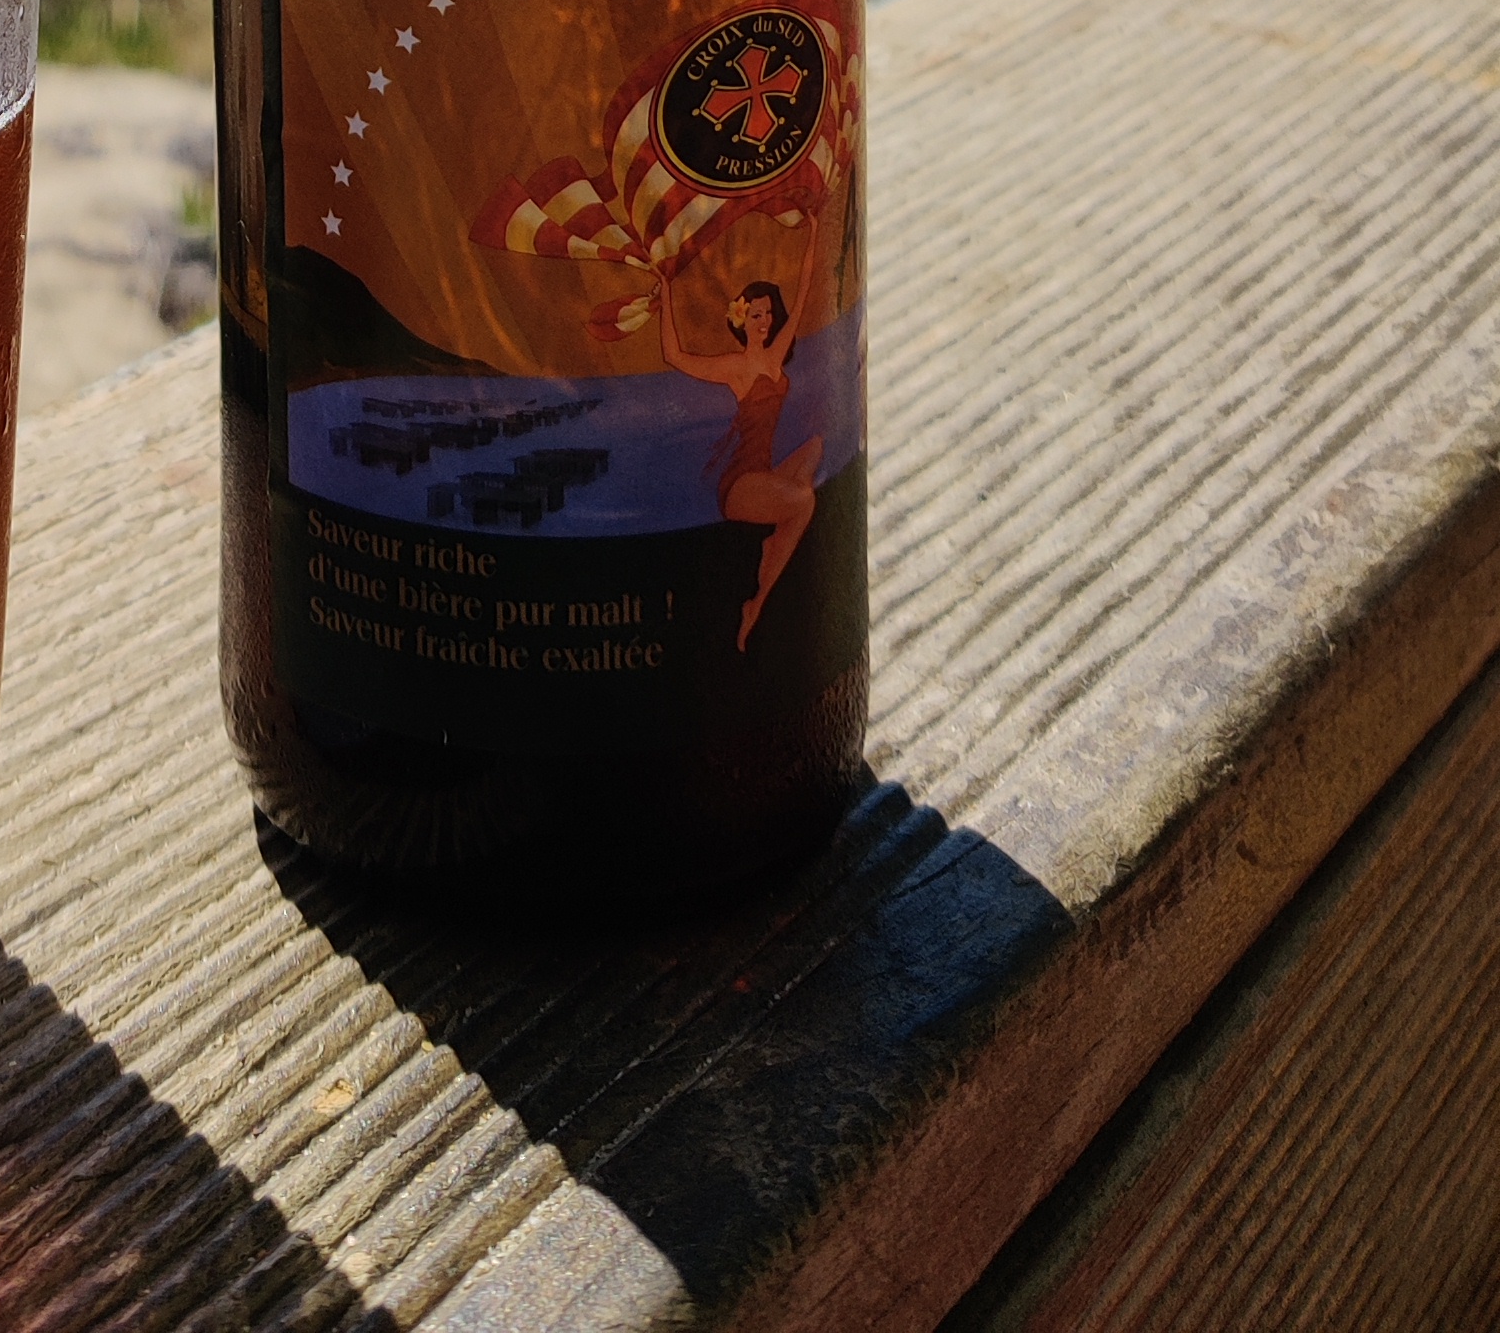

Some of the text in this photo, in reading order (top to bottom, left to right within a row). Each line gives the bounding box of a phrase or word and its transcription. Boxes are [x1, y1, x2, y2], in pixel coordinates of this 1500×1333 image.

[687, 16, 806, 81] CROIX du SUD
[715, 124, 802, 177] PRESSION
[307, 507, 498, 579] Saveur riche
[307, 551, 388, 604] d'une
[397, 575, 485, 622] bière
[493, 598, 556, 632] pur
[566, 590, 644, 628] malt
[308, 594, 666, 674] Saveur fraîche exaltée
